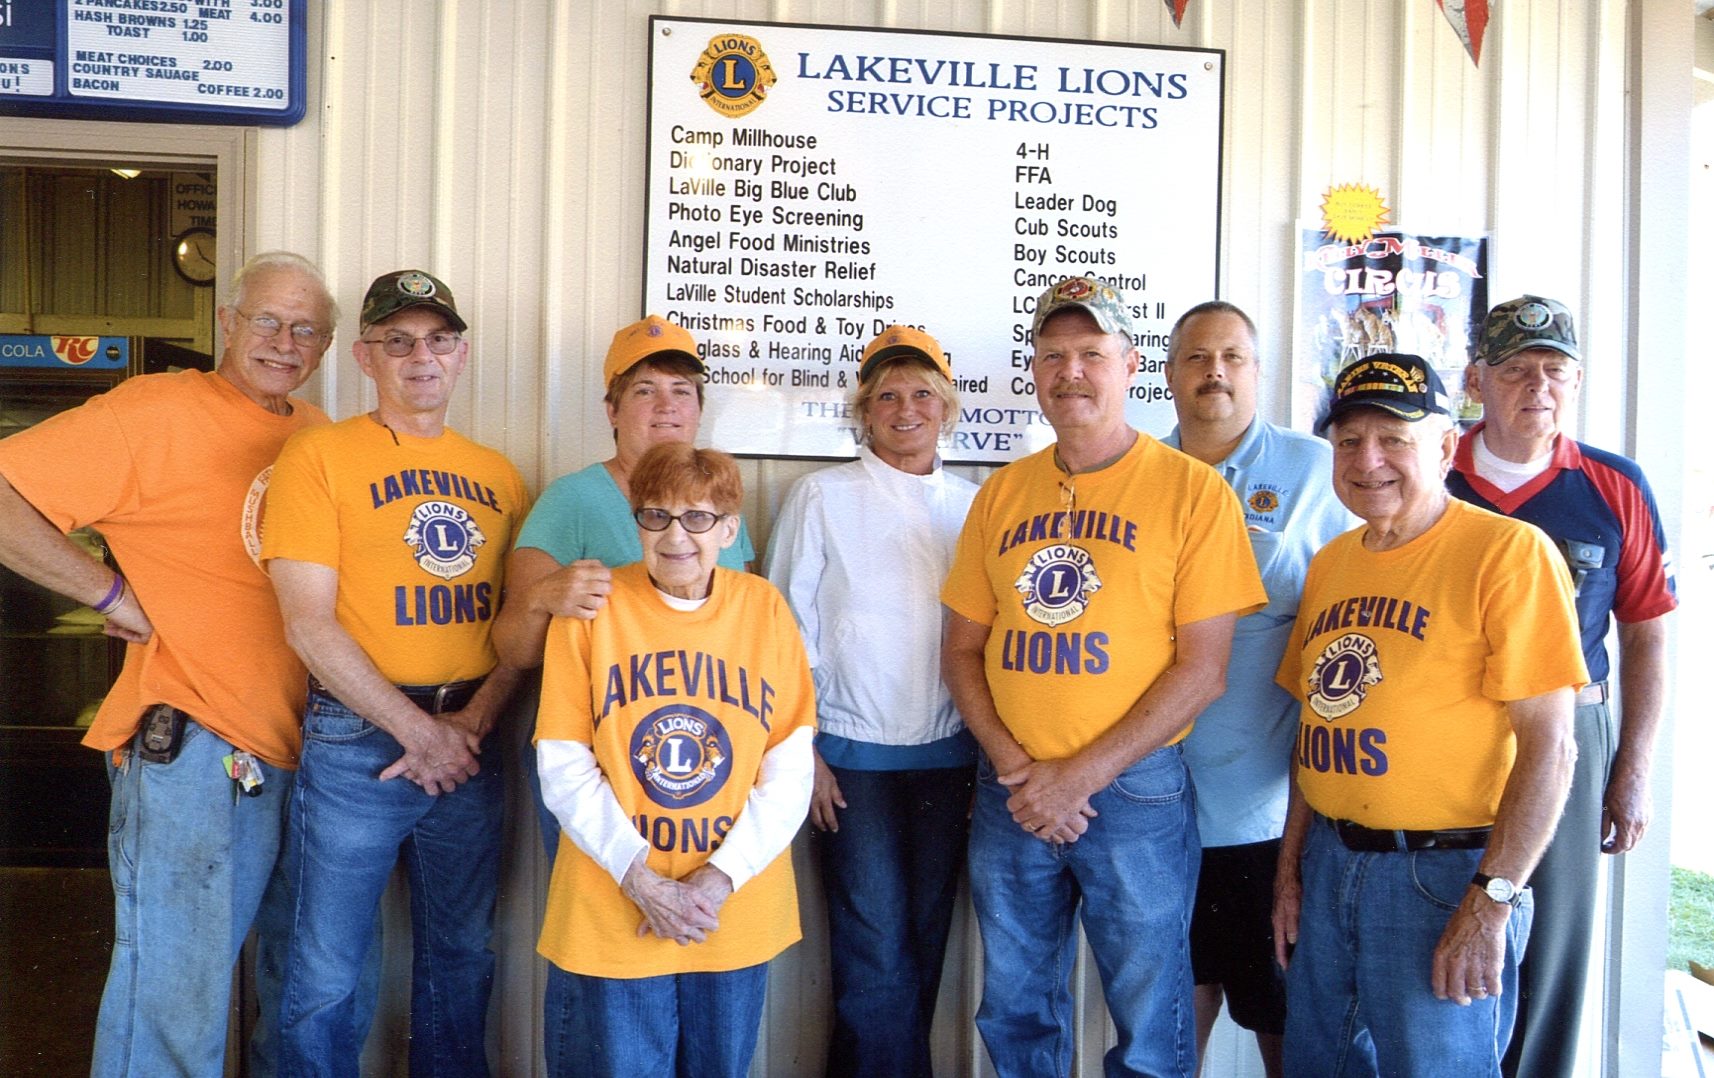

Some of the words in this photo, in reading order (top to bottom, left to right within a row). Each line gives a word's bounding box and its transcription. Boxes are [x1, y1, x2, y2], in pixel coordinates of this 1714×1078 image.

[75, 10, 112, 23] HASH
[118, 13, 177, 28] BROWNS
[183, 19, 208, 30] 1.25
[199, 8, 232, 20] MEAT
[250, 12, 283, 24] 4.00
[107, 25, 150, 38] TOAST
[182, 31, 208, 42] 1.00
[713, 38, 757, 57] LIONS
[73, 63, 139, 78] COUNTRY
[146, 68, 199, 81] SAUAGE
[76, 51, 114, 63] MEAT
[118, 53, 177, 67] CHOICES
[203, 60, 233, 72] 2.00
[73, 79, 119, 91] BACON
[722, 59, 745, 89] L
[797, 52, 1038, 91] LAKEVILLE
[1057, 67, 1188, 100] LIONS
[198, 84, 250, 97] COFFEE
[253, 87, 284, 99] 2.00
[711, 96, 757, 112] INTERNATIONAL
[827, 90, 972, 119] SERVICE
[987, 98, 1159, 130] PROJECTS
[671, 125, 724, 148] Camp
[732, 128, 817, 149] Millhouse
[1016, 142, 1049, 161] 4-H
[771, 155, 836, 177] Project
[1015, 166, 1052, 185] FFA
[669, 177, 726, 197] LaVille
[734, 179, 762, 202] Big
[771, 181, 809, 200] Blue
[817, 182, 857, 202] Club
[1014, 191, 1074, 211] Leader
[1082, 195, 1117, 216] Dog
[668, 202, 721, 223] Photo
[730, 205, 763, 226] Eye
[772, 206, 864, 231] Screening
[1015, 217, 1049, 236] Cub
[1057, 219, 1118, 239] Scouts
[669, 230, 721, 253] Angel
[729, 232, 775, 251] Food
[784, 234, 871, 255] Ministries
[1014, 243, 1047, 265] Boy
[1055, 245, 1116, 265] Scouts
[667, 256, 732, 275] Natural
[741, 258, 816, 278] Disaster
[824, 261, 876, 281] Relief
[1324, 268, 1462, 298] CIRCUS
[667, 283, 716, 302] LaVille
[724, 285, 786, 305] Student
[793, 287, 894, 312] Scholarships
[667, 310, 755, 332] Christmas
[763, 315, 807, 334] Food
[815, 316, 827, 335] &
[836, 317, 865, 339] Toy
[2, 344, 45, 358] COLA
[52, 336, 98, 363] RC
[697, 339, 741, 360] glass
[749, 340, 760, 358] &
[769, 341, 832, 365] Hearing
[763, 368, 785, 386] for
[792, 369, 829, 388] Blind
[837, 371, 848, 388] &
[370, 469, 502, 514] LAKEVILLE
[418, 503, 465, 521] LIONS
[434, 524, 458, 551] L
[999, 510, 1138, 557] LAKEVILLE
[423, 558, 471, 574] INTERNATIONAL
[1037, 547, 1087, 564] LIONS
[1049, 570, 1069, 598] L
[395, 581, 492, 626] LIONS
[1032, 605, 1080, 620] INTERNATIONAL
[1302, 596, 1430, 651] LAKEVILLE
[1002, 629, 1109, 675] LIONS
[1329, 636, 1373, 655] LIONS
[1329, 661, 1350, 689] L
[658, 717, 704, 736] LIONS
[667, 738, 692, 773] L
[632, 814, 733, 854] IONS
